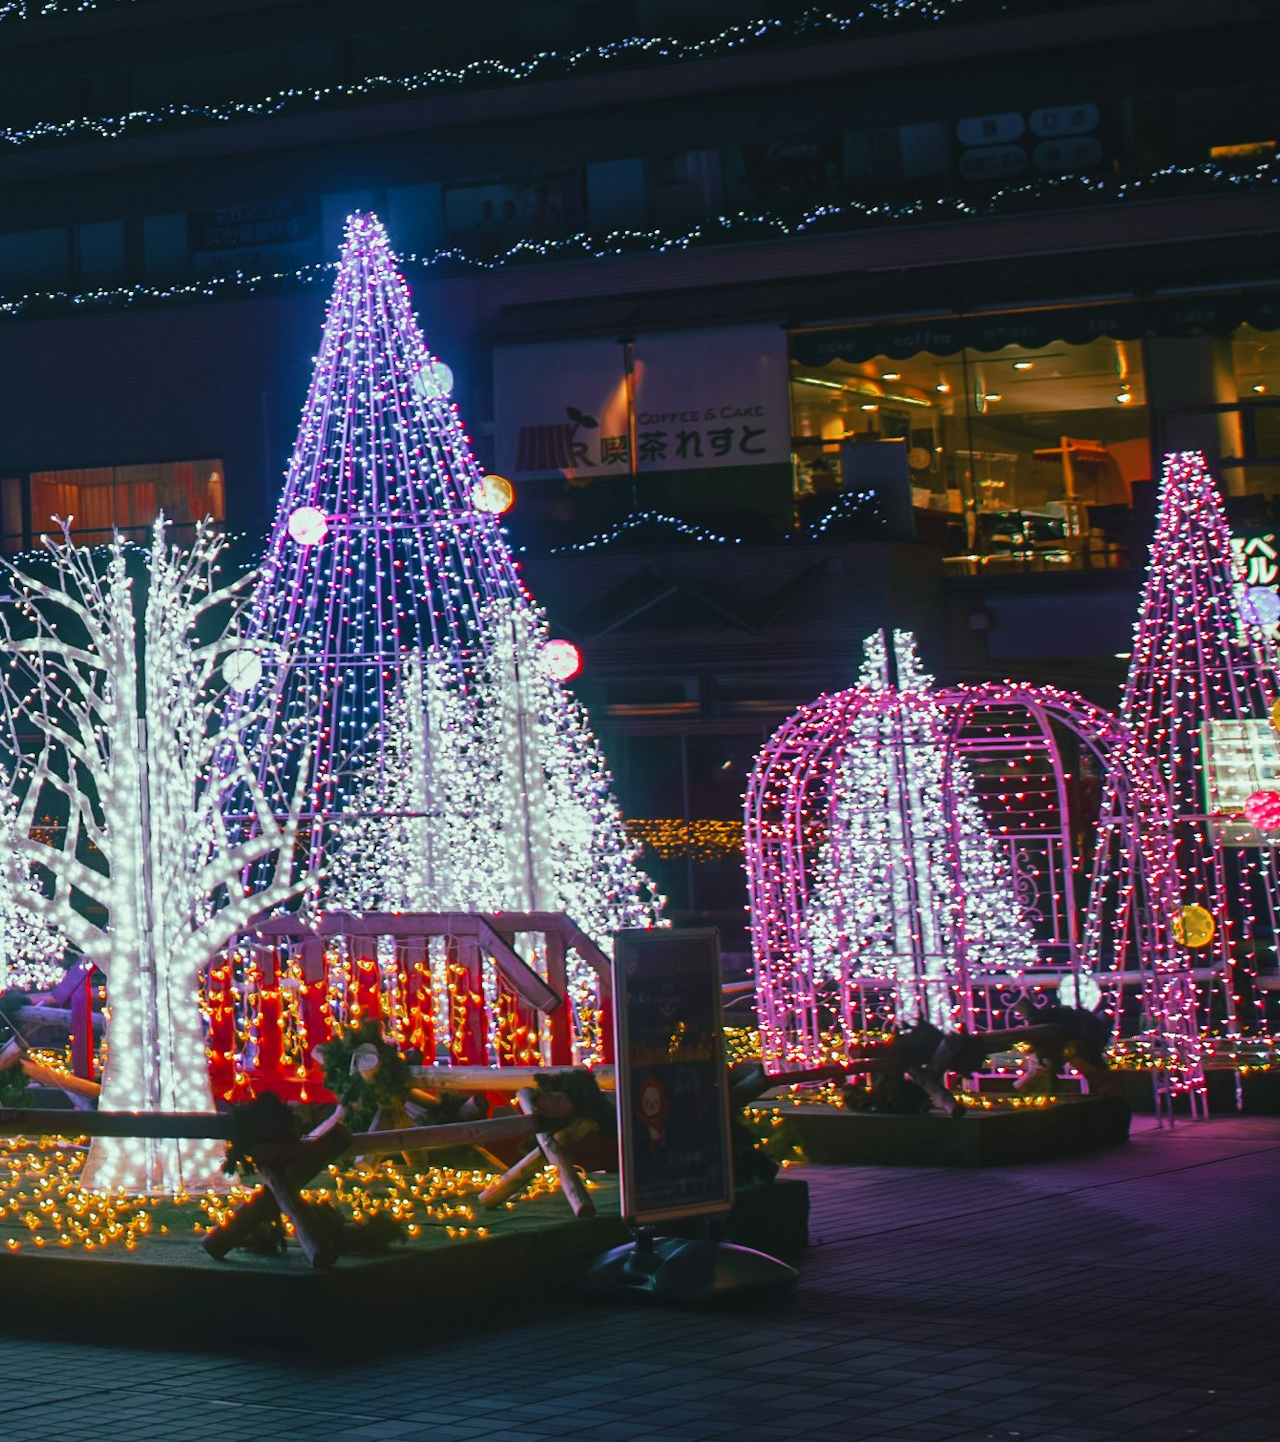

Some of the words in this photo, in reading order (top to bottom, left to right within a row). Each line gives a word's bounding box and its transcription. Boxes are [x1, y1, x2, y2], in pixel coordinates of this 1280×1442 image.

[894, 331, 952, 348] coffee
[600, 426, 767, 464] 喫茶れすと
